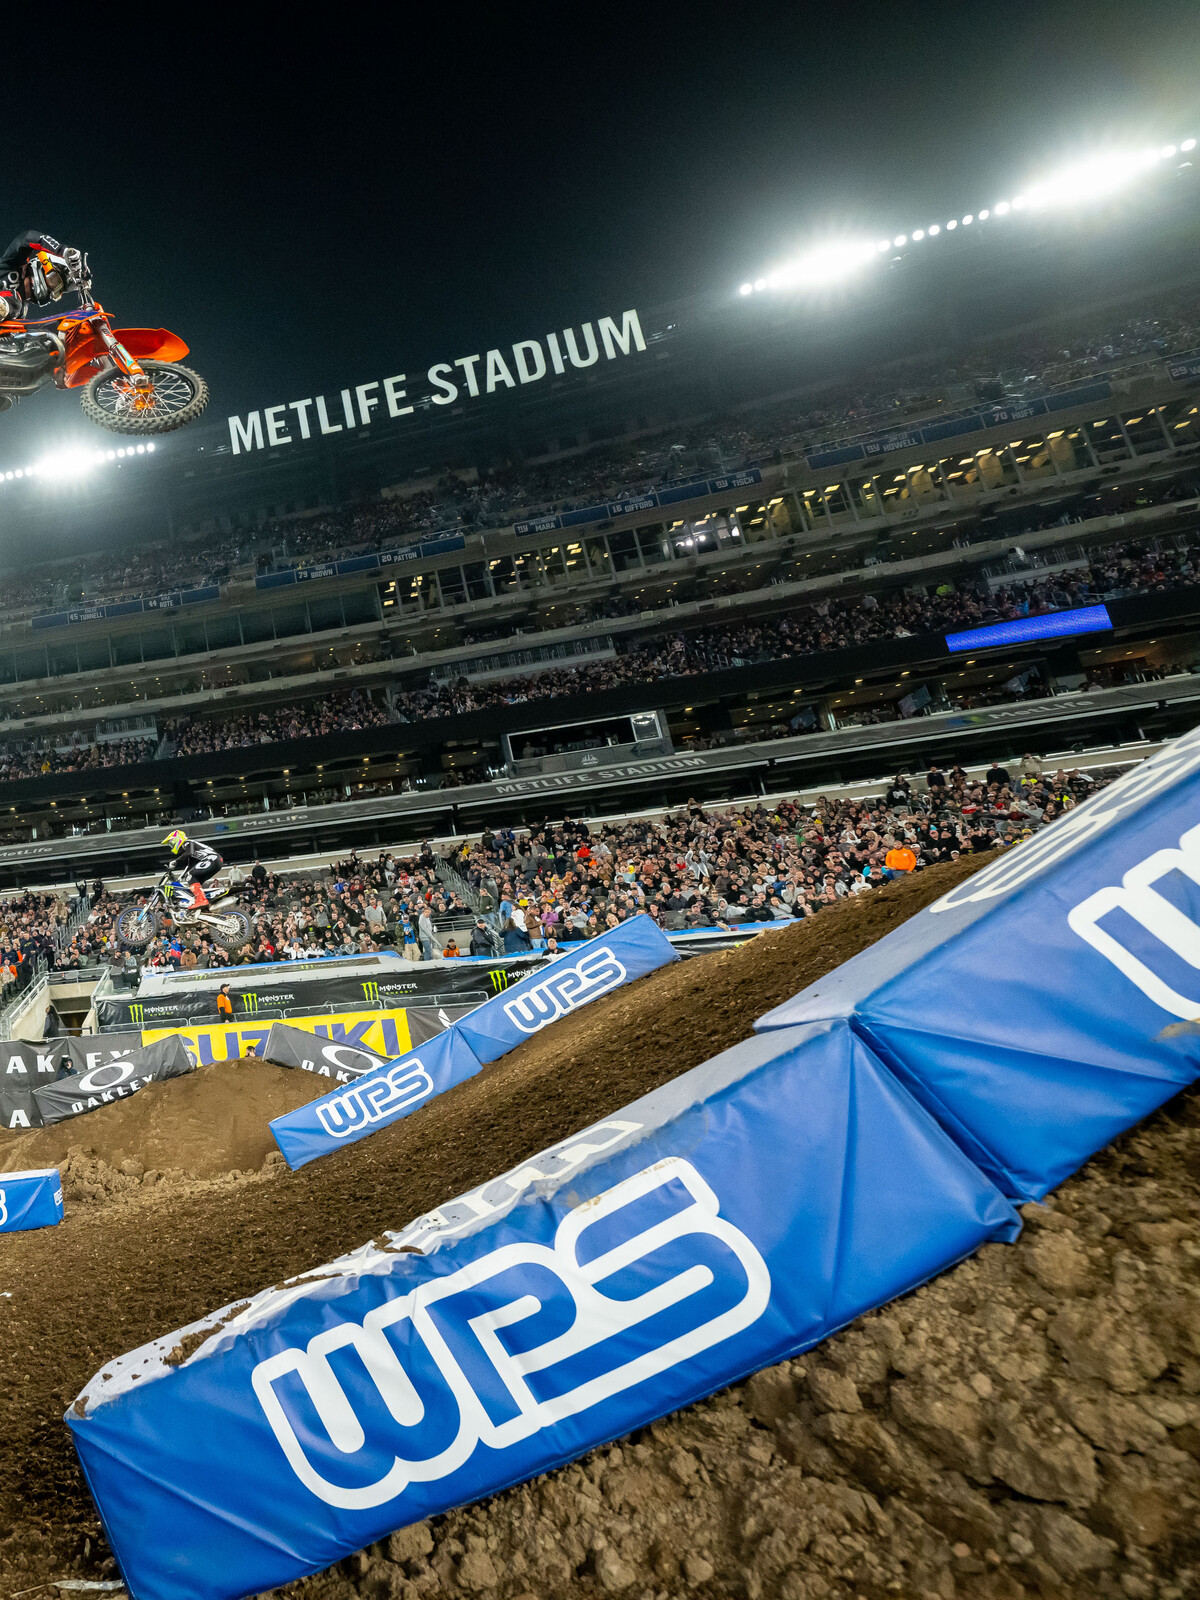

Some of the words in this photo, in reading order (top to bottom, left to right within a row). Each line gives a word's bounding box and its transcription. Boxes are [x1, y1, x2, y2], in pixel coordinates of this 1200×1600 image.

[228, 373, 414, 456] METLIFE
[427, 308, 647, 405] STADIUM
[1012, 407, 1036, 421] HUFF
[882, 437, 919, 452] HOWELL
[732, 476, 754, 488] TISCH
[611, 505, 622, 513] 16
[625, 500, 654, 513] GIFFORD
[535, 521, 555, 533] MARA
[382, 554, 392, 563] 20
[393, 551, 417, 563] PATTON
[310, 568, 333, 579] BROWN
[69, 613, 79, 621] 45
[79, 611, 103, 621] TUNNELL
[988, 699, 1094, 720] MetLife
[496, 774, 596, 794] METLIFE
[598, 757, 707, 779] STADIUM
[242, 814, 308, 828] MetLife
[378, 982, 418, 992] MONSTER
[503, 946, 626, 1034] WPS
[258, 993, 295, 1003] MONSTER
[144, 1005, 179, 1014] MONSTER
[181, 1018, 402, 1067] SUZKI
[301, 1059, 351, 1083] OAK
[71, 1074, 154, 1113] OAKLEY
[315, 1057, 434, 1138] WPS
[251, 1156, 771, 1510] WPS
